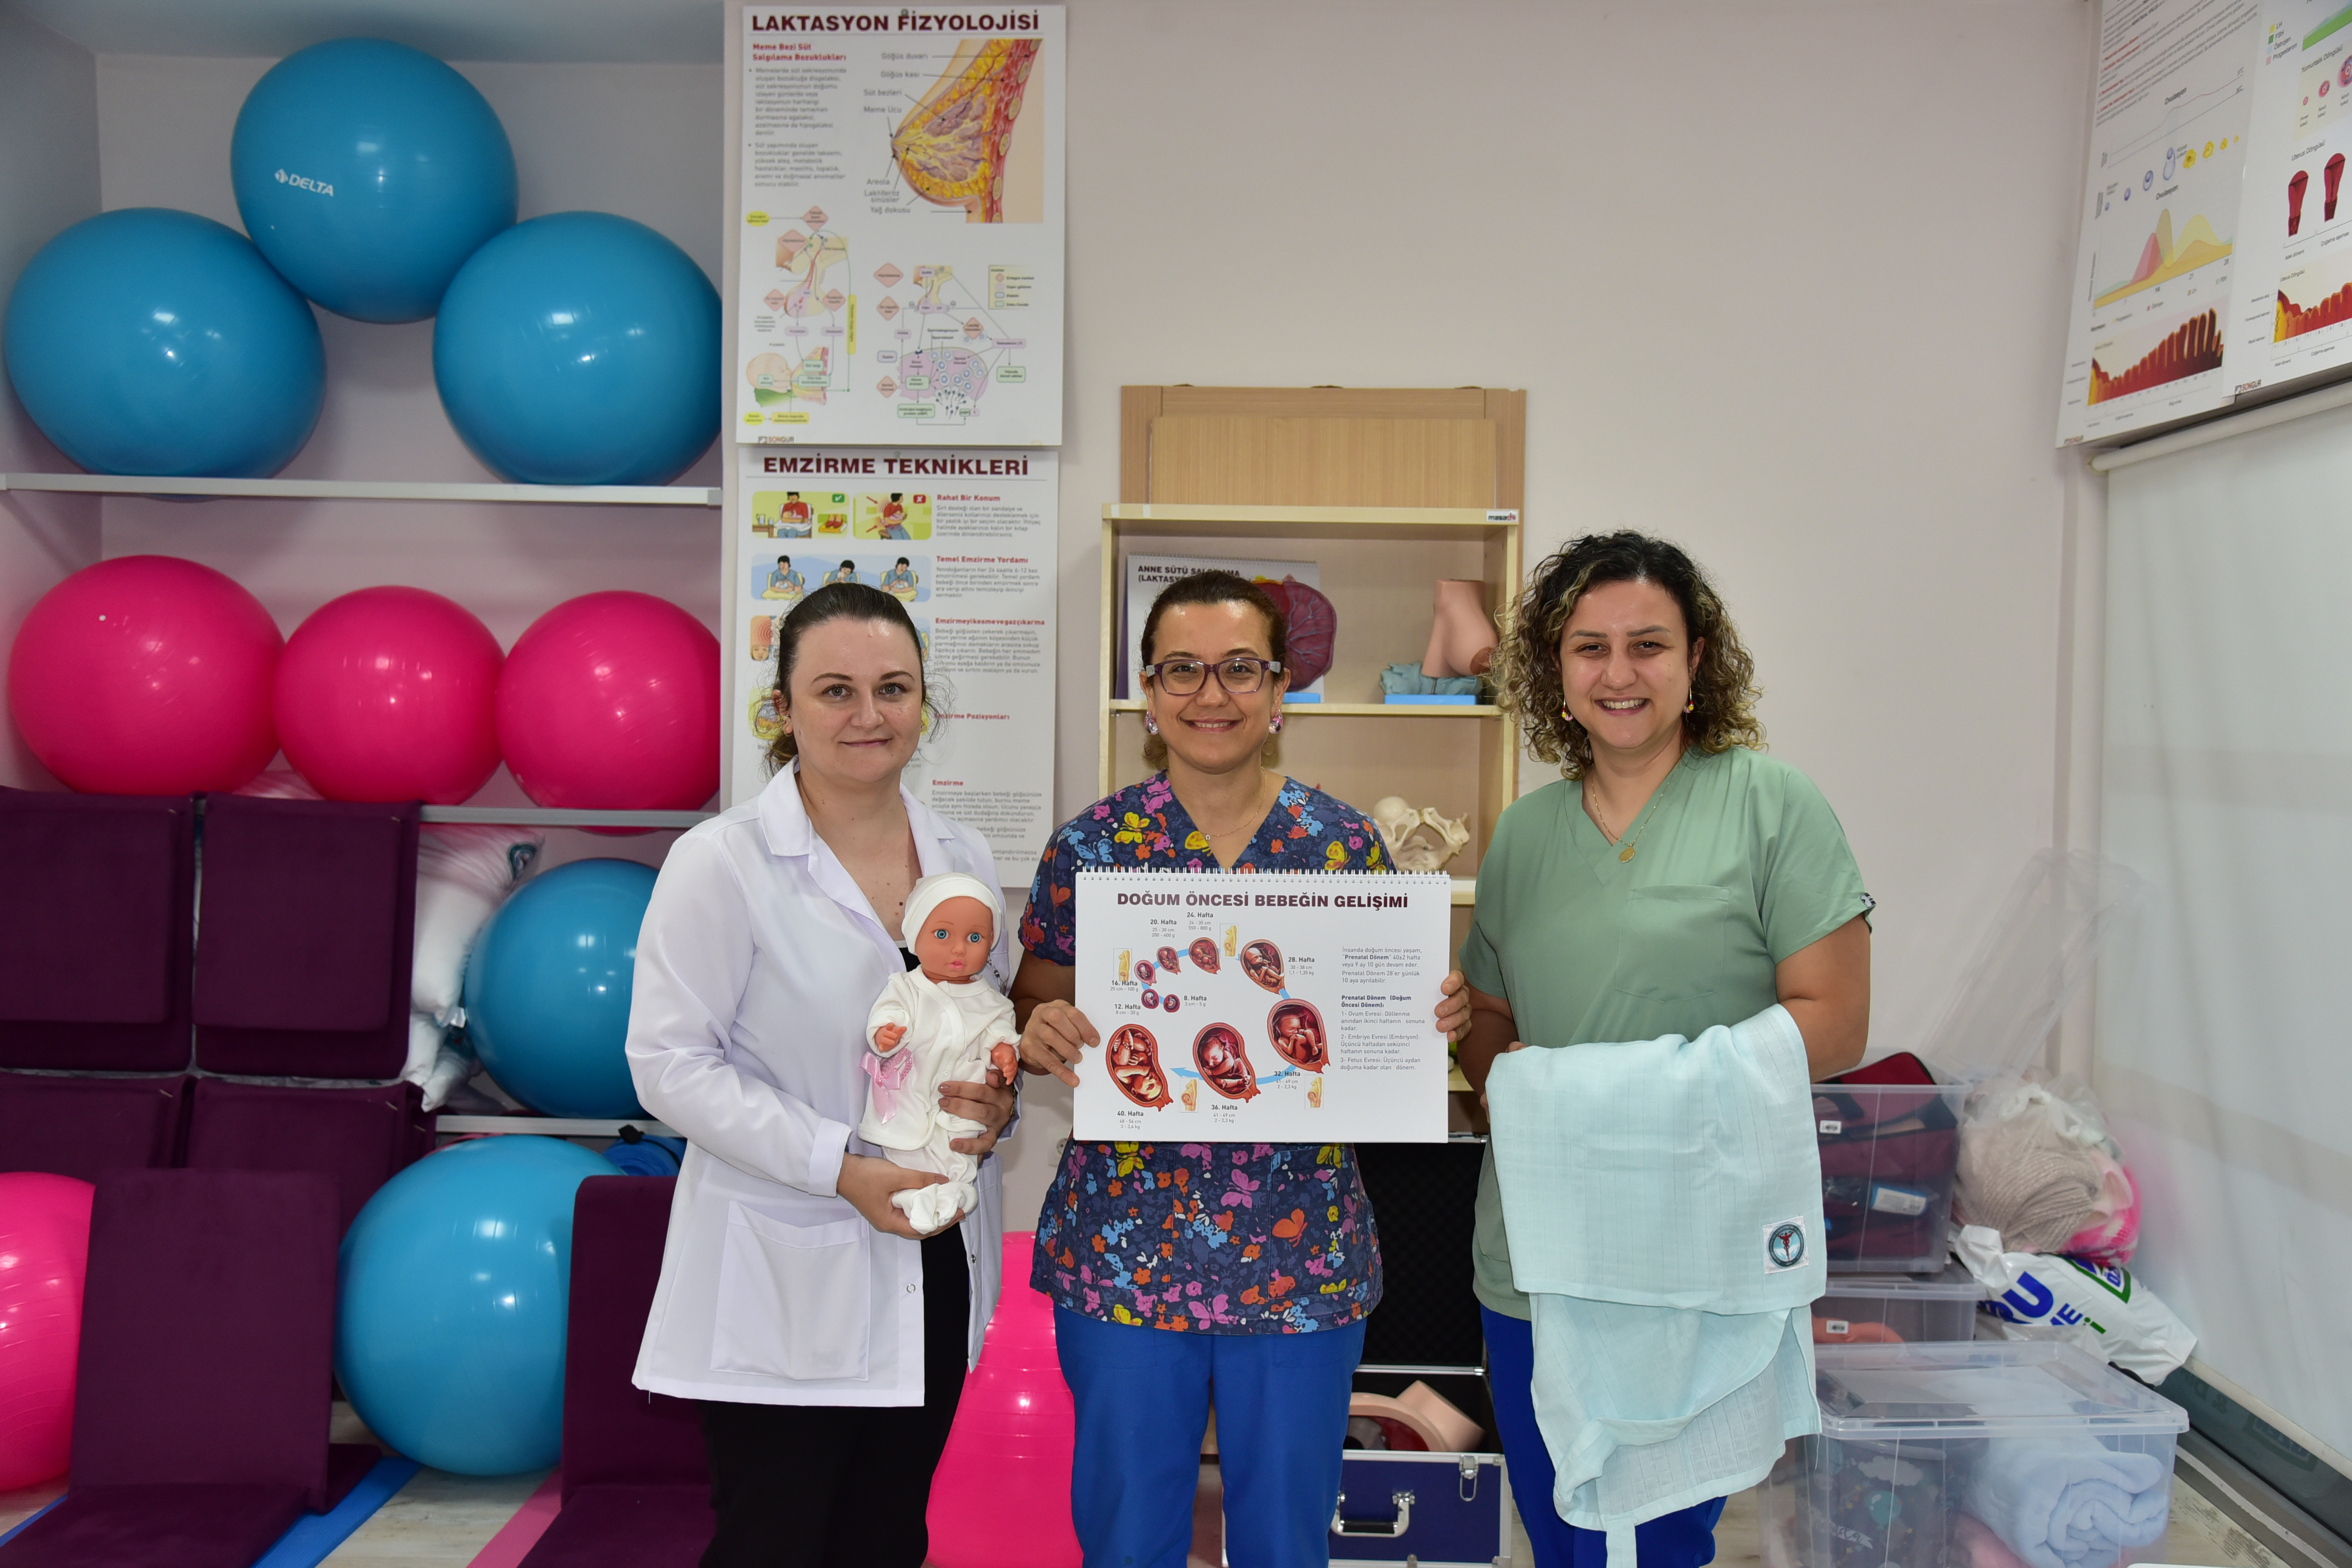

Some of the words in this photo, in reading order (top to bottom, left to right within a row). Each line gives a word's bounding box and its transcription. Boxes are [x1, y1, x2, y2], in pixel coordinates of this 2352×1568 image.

[752, 15, 889, 31] LAKTASYON
[898, 10, 1039, 31] FİZYOLOJİSİ
[2276, 21, 2283, 29] LH
[2275, 30, 2284, 40] FSH
[288, 174, 334, 197] DELTA
[2241, 379, 2262, 391] SONGUR
[764, 453, 875, 474] EMZİRME
[884, 455, 1028, 476] TEKNİKLERİ
[1165, 565, 1188, 574] SÜTÜ
[1118, 890, 1180, 905] DOĞUM
[1186, 891, 1249, 906] ÖNCESİ
[1255, 892, 1328, 907] BEBEĞİN
[1334, 892, 1408, 911] GELİŞİMİ
